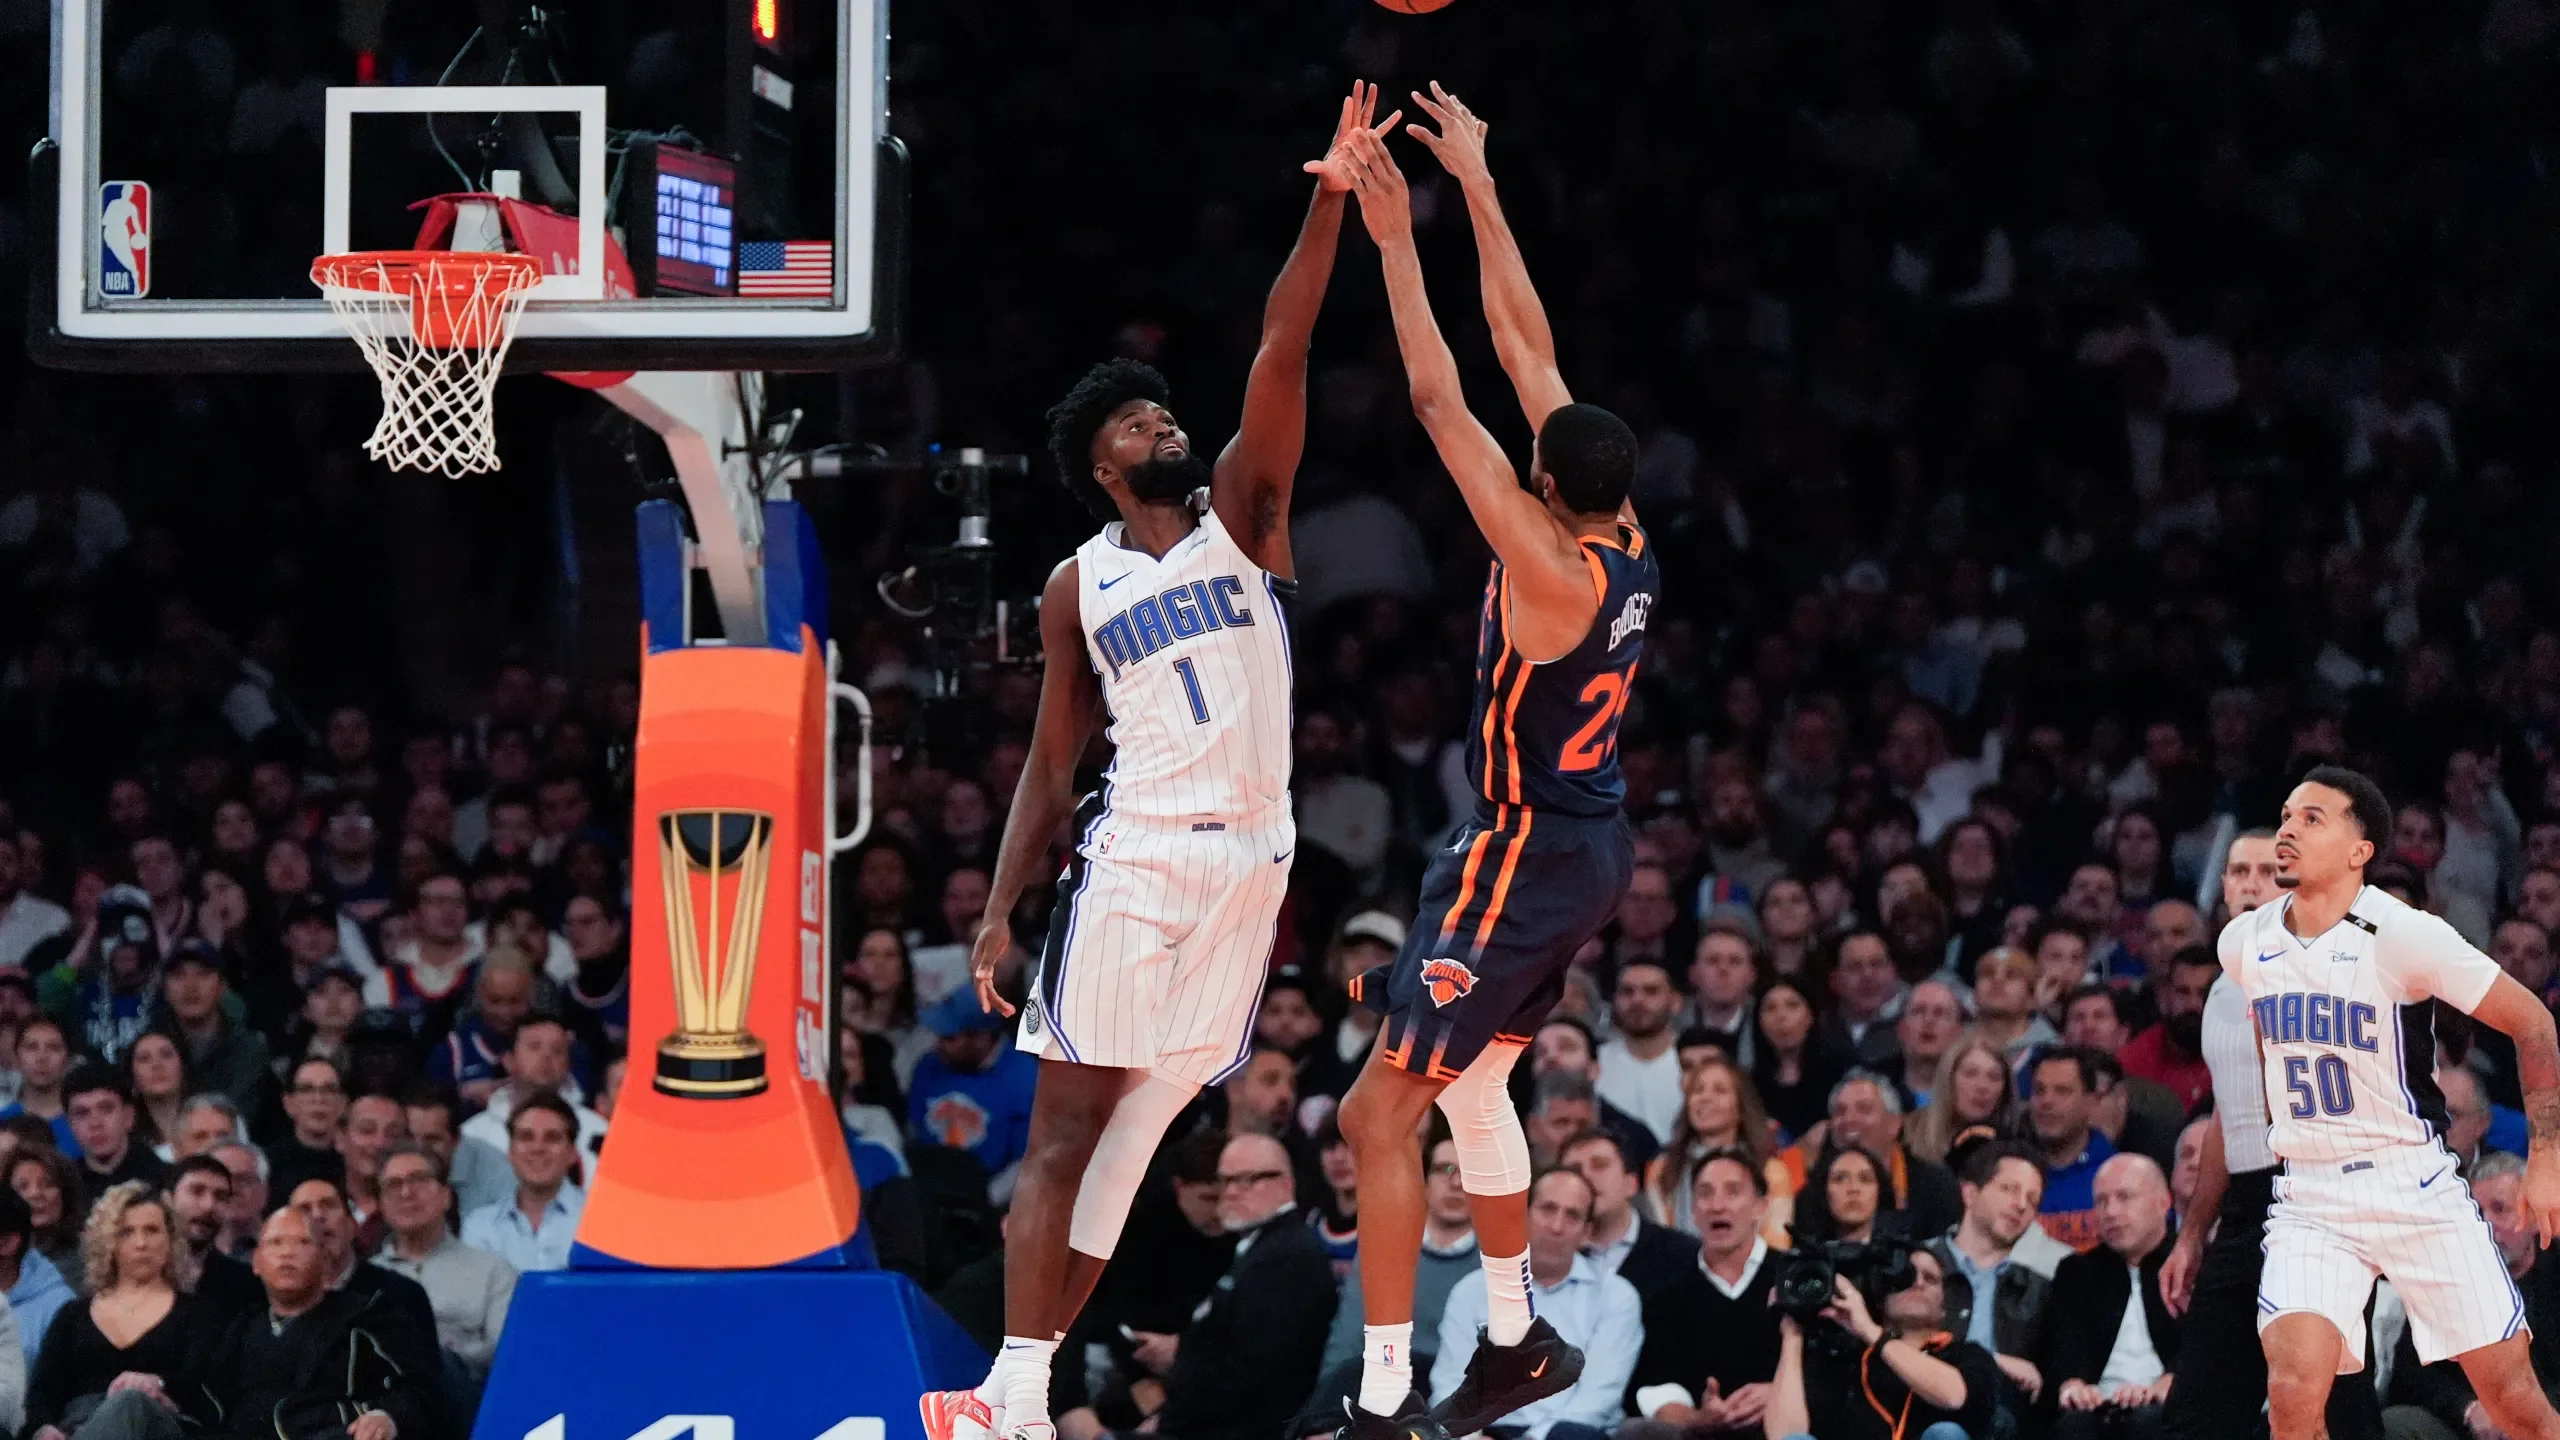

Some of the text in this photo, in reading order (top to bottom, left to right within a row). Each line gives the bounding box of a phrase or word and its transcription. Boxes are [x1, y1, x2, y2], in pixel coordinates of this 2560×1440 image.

[105, 272, 129, 291] NBA
[1093, 575, 1255, 683] MAGIC
[1173, 656, 1210, 725] 1
[1423, 961, 1470, 992] KNICKS
[2328, 949, 2360, 965] Disney
[2252, 992, 2379, 1053] MAGIC
[2284, 1053, 2355, 1119] 50
